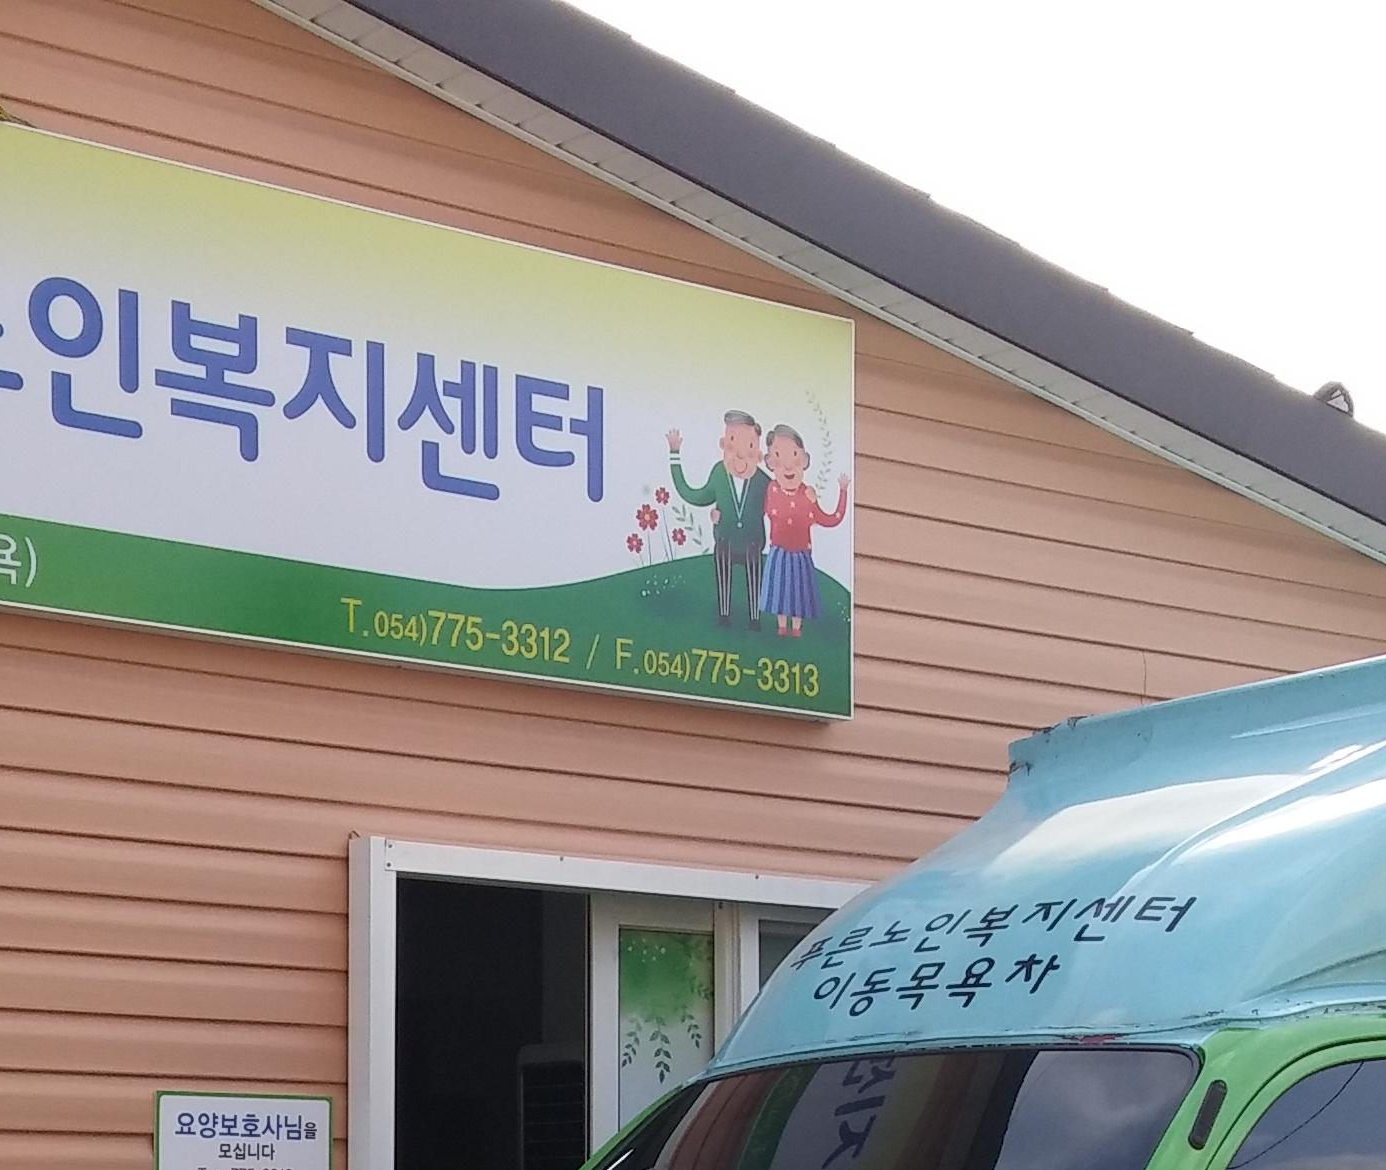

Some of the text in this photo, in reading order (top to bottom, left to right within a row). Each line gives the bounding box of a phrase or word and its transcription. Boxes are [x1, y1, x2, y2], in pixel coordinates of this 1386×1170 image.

[791, 896, 1196, 969] 푸른노인복지센터
[813, 953, 1059, 1017] 이동목욕차
[174, 1112, 318, 1141] 요양보호사님을
[218, 1143, 275, 1161] 모십니다
